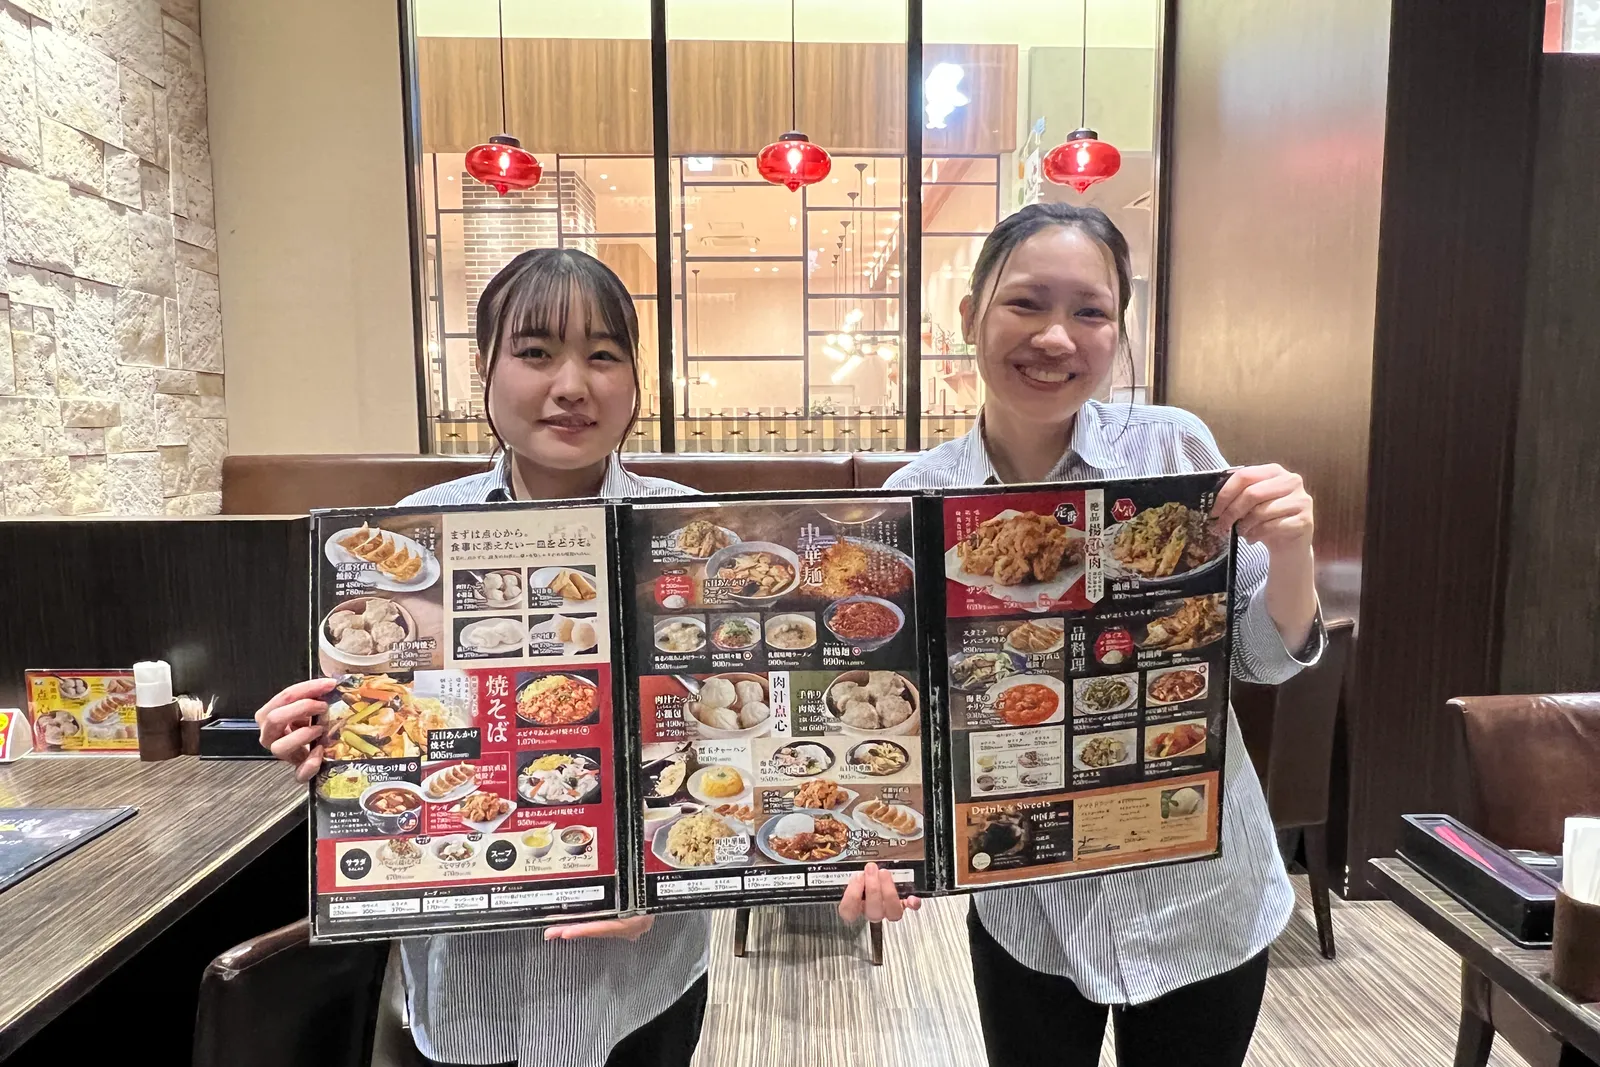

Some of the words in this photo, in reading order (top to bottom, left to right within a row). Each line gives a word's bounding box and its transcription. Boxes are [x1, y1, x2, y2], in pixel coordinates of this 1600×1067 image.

[451, 529, 529, 540] まずは点心から。
[451, 538, 591, 552] 食事に添えたい一皿をどうぞ。
[800, 523, 824, 588] 中華麺
[963, 629, 988, 637] スタミナ
[486, 675, 509, 743] 焼そば
[773, 676, 788, 732] 肉汁点心
[430, 730, 478, 741] 五目あんかけ
[430, 741, 455, 750] 焼そば
[972, 803, 1003, 815] Drink
[1017, 801, 1051, 811] Sweets
[491, 849, 512, 858] スープ
[345, 858, 367, 867] サラダ
